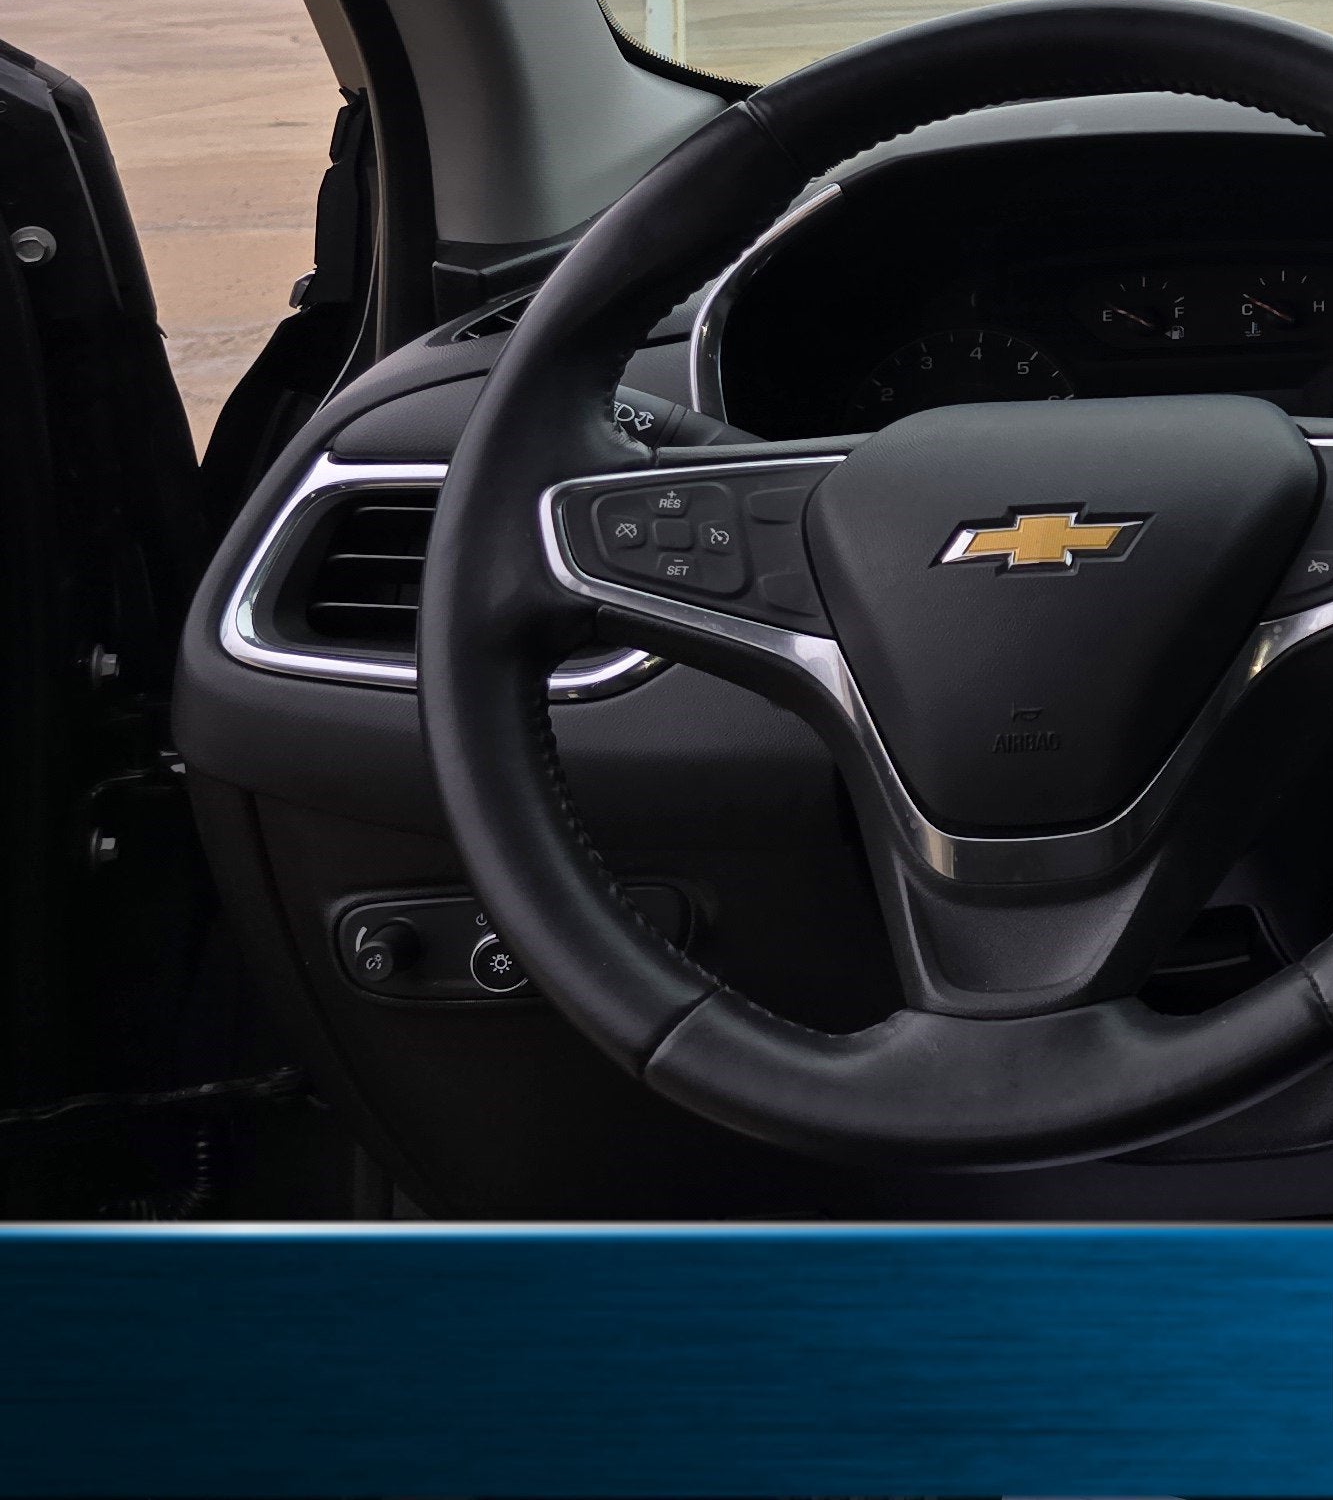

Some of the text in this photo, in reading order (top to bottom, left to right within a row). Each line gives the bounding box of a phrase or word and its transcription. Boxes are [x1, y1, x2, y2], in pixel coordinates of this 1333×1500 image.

[1174, 307, 1185, 319] F
[1241, 303, 1254, 316] C
[1313, 301, 1325, 312] H
[1102, 309, 1113, 322] E
[969, 346, 984, 360] 4
[919, 356, 933, 370] 3
[1016, 362, 1030, 375] 5
[880, 387, 896, 402] 2
[658, 498, 682, 509] RES
[666, 565, 689, 576] SET
[992, 731, 1061, 754] AIRBAG
